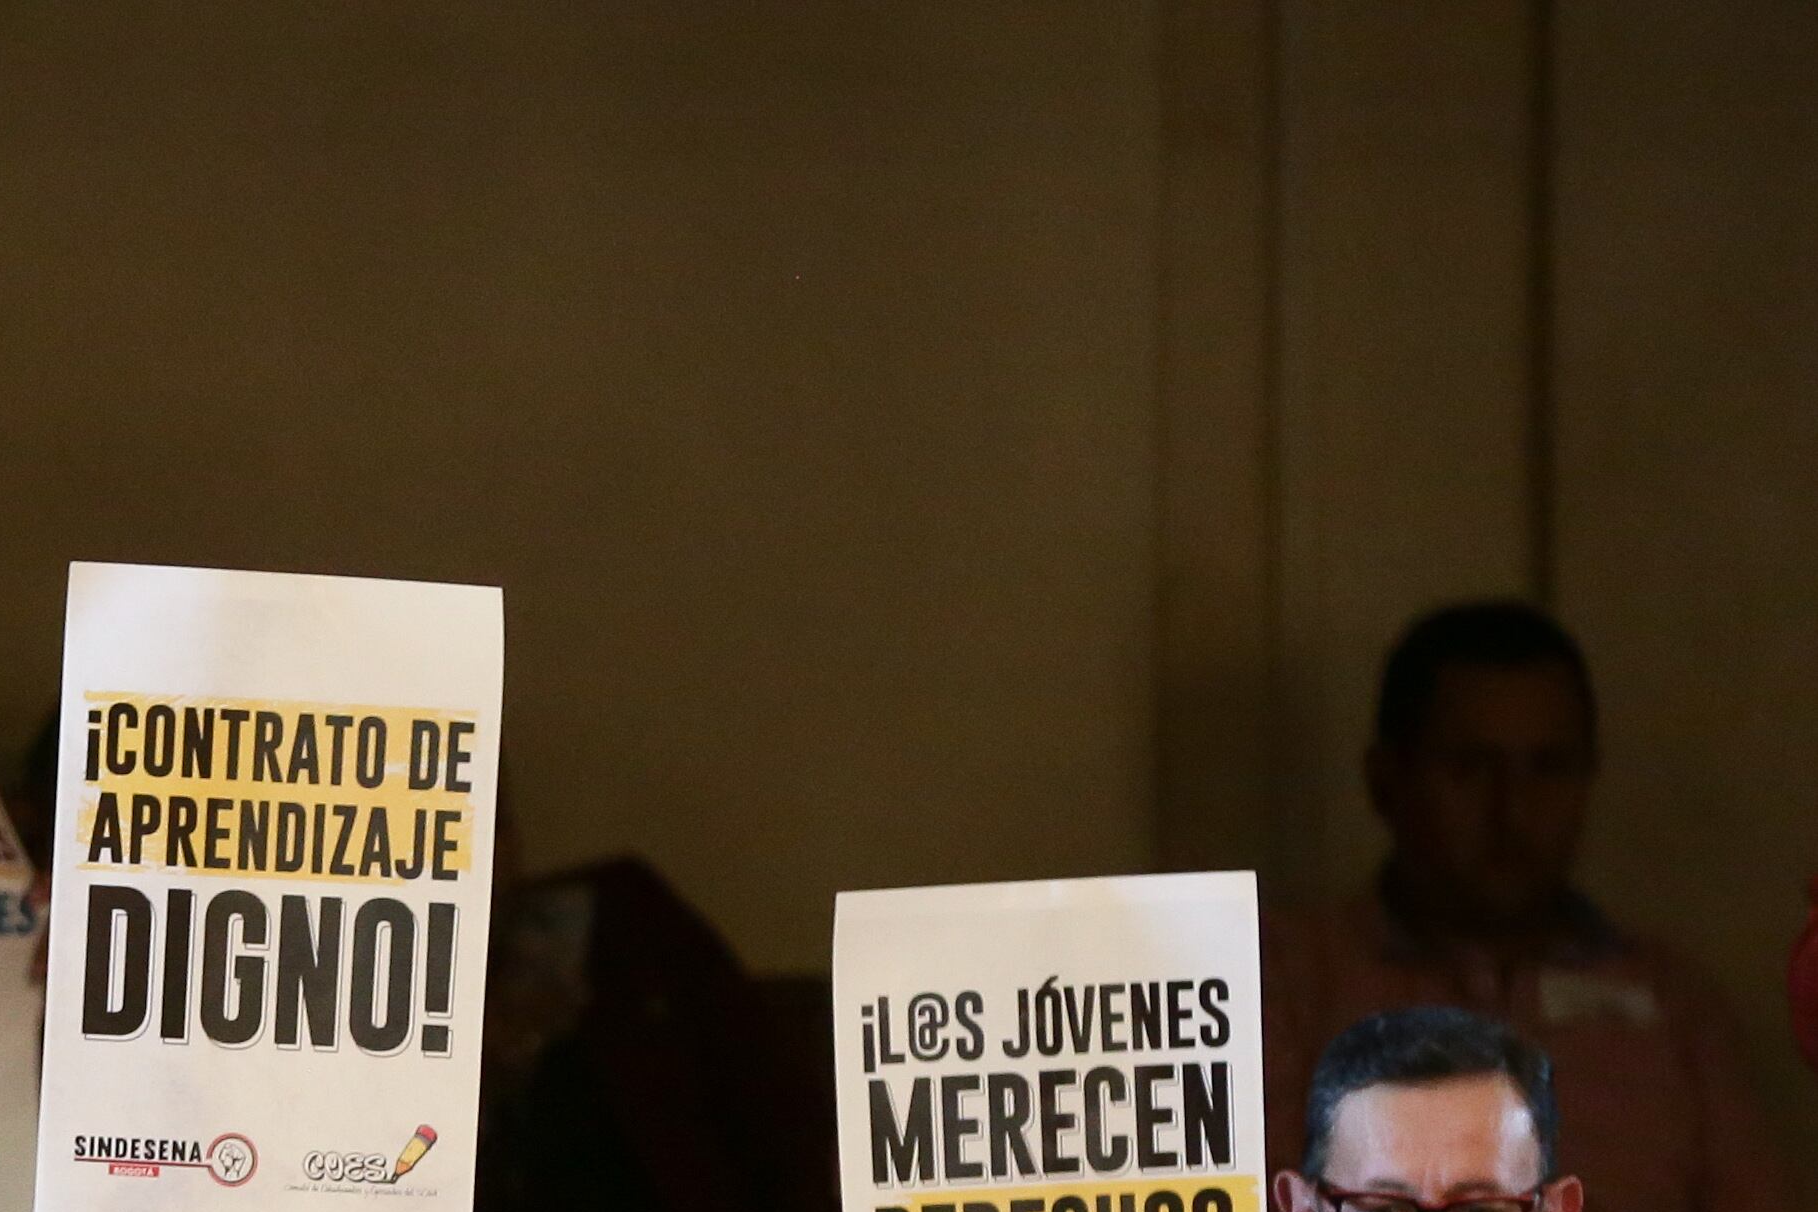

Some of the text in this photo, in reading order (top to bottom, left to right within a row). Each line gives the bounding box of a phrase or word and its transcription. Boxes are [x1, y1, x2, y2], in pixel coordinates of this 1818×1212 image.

[85, 702, 476, 793] ¡CONTRATO DE
[87, 791, 463, 881] APRENDIZAJE
[82, 884, 457, 1058] DIGNO!
[862, 975, 1230, 1073] ¡L@S JÓVENES
[74, 1135, 202, 1163] SINDESENA
[869, 1061, 1235, 1187] MERECEN
